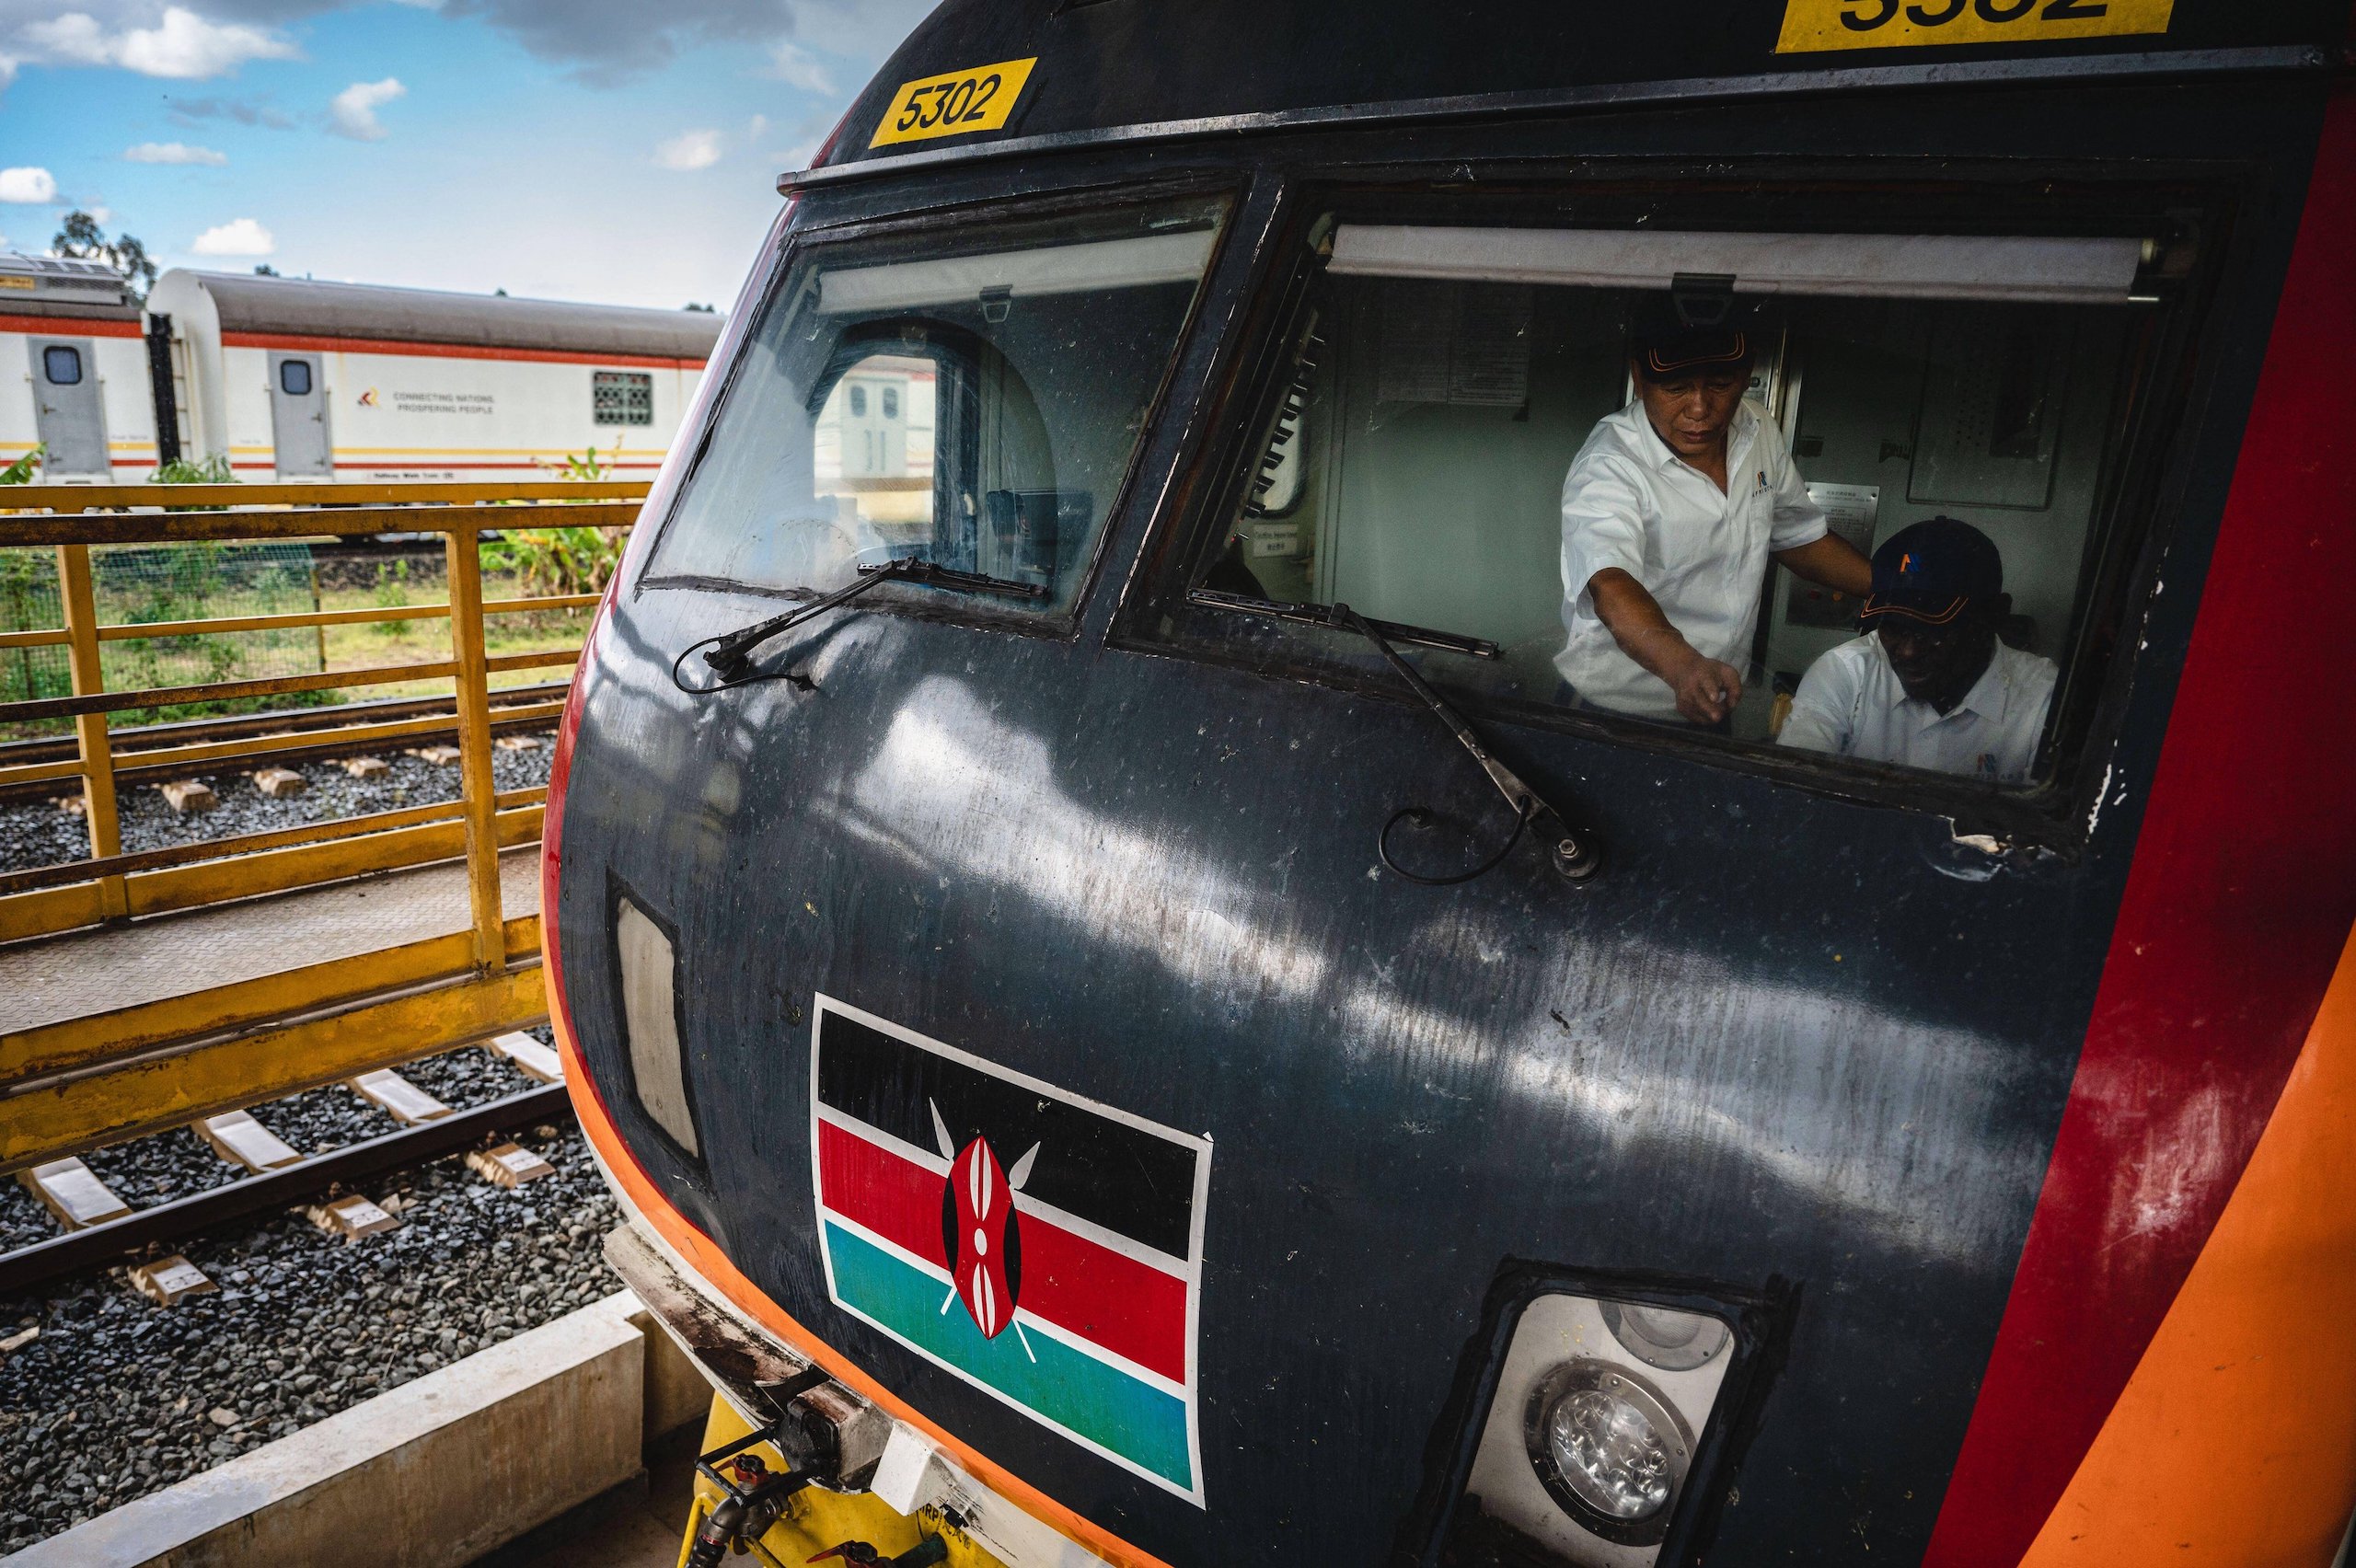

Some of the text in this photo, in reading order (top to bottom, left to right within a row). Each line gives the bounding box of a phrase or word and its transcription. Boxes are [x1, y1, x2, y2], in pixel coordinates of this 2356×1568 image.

[896, 74, 1001, 132] 5302
[393, 391, 494, 404] CONNECTING NATIONS
[398, 403, 493, 414] PROSPERING PEOPLE
